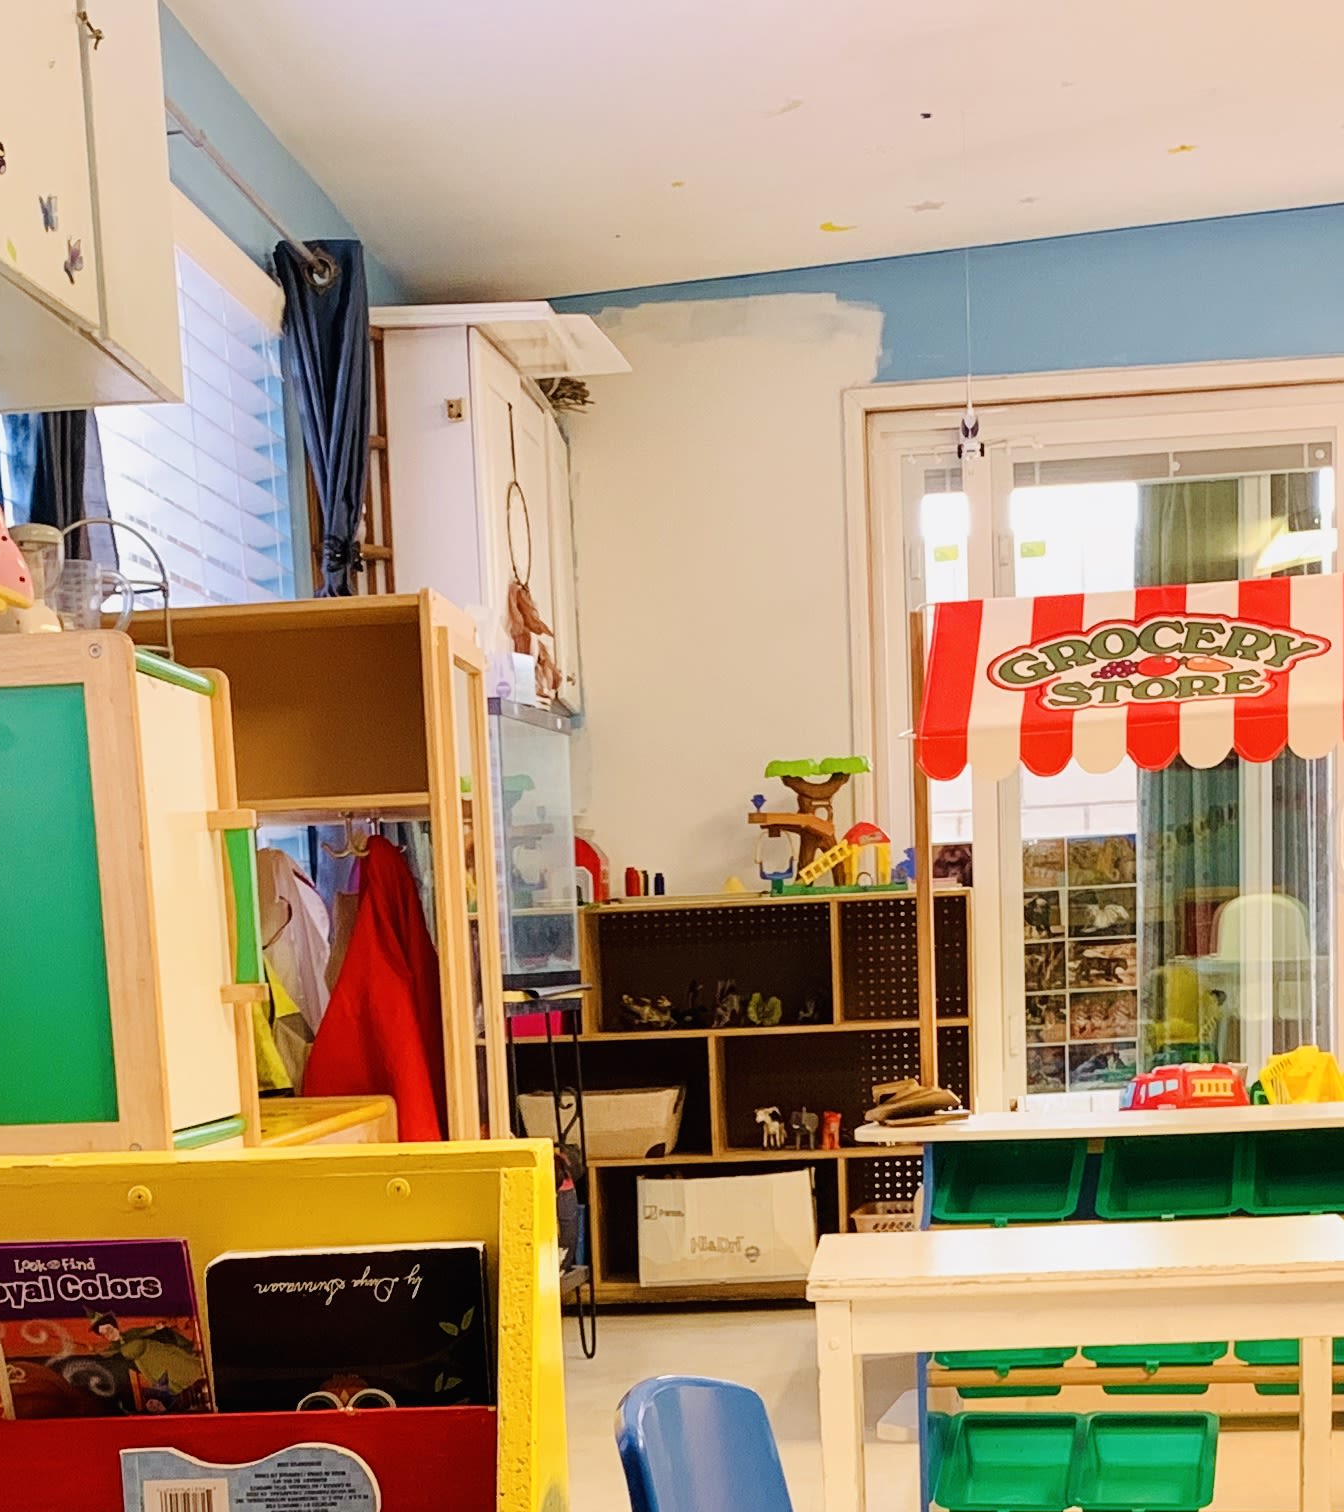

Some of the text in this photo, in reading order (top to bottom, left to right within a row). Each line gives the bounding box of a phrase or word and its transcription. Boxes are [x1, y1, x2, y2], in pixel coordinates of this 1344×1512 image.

[997, 620, 1320, 686] GROCERY
[1046, 668, 1266, 707] STORE
[56, 1273, 164, 1302] Colors
[403, 1263, 423, 1300] by
